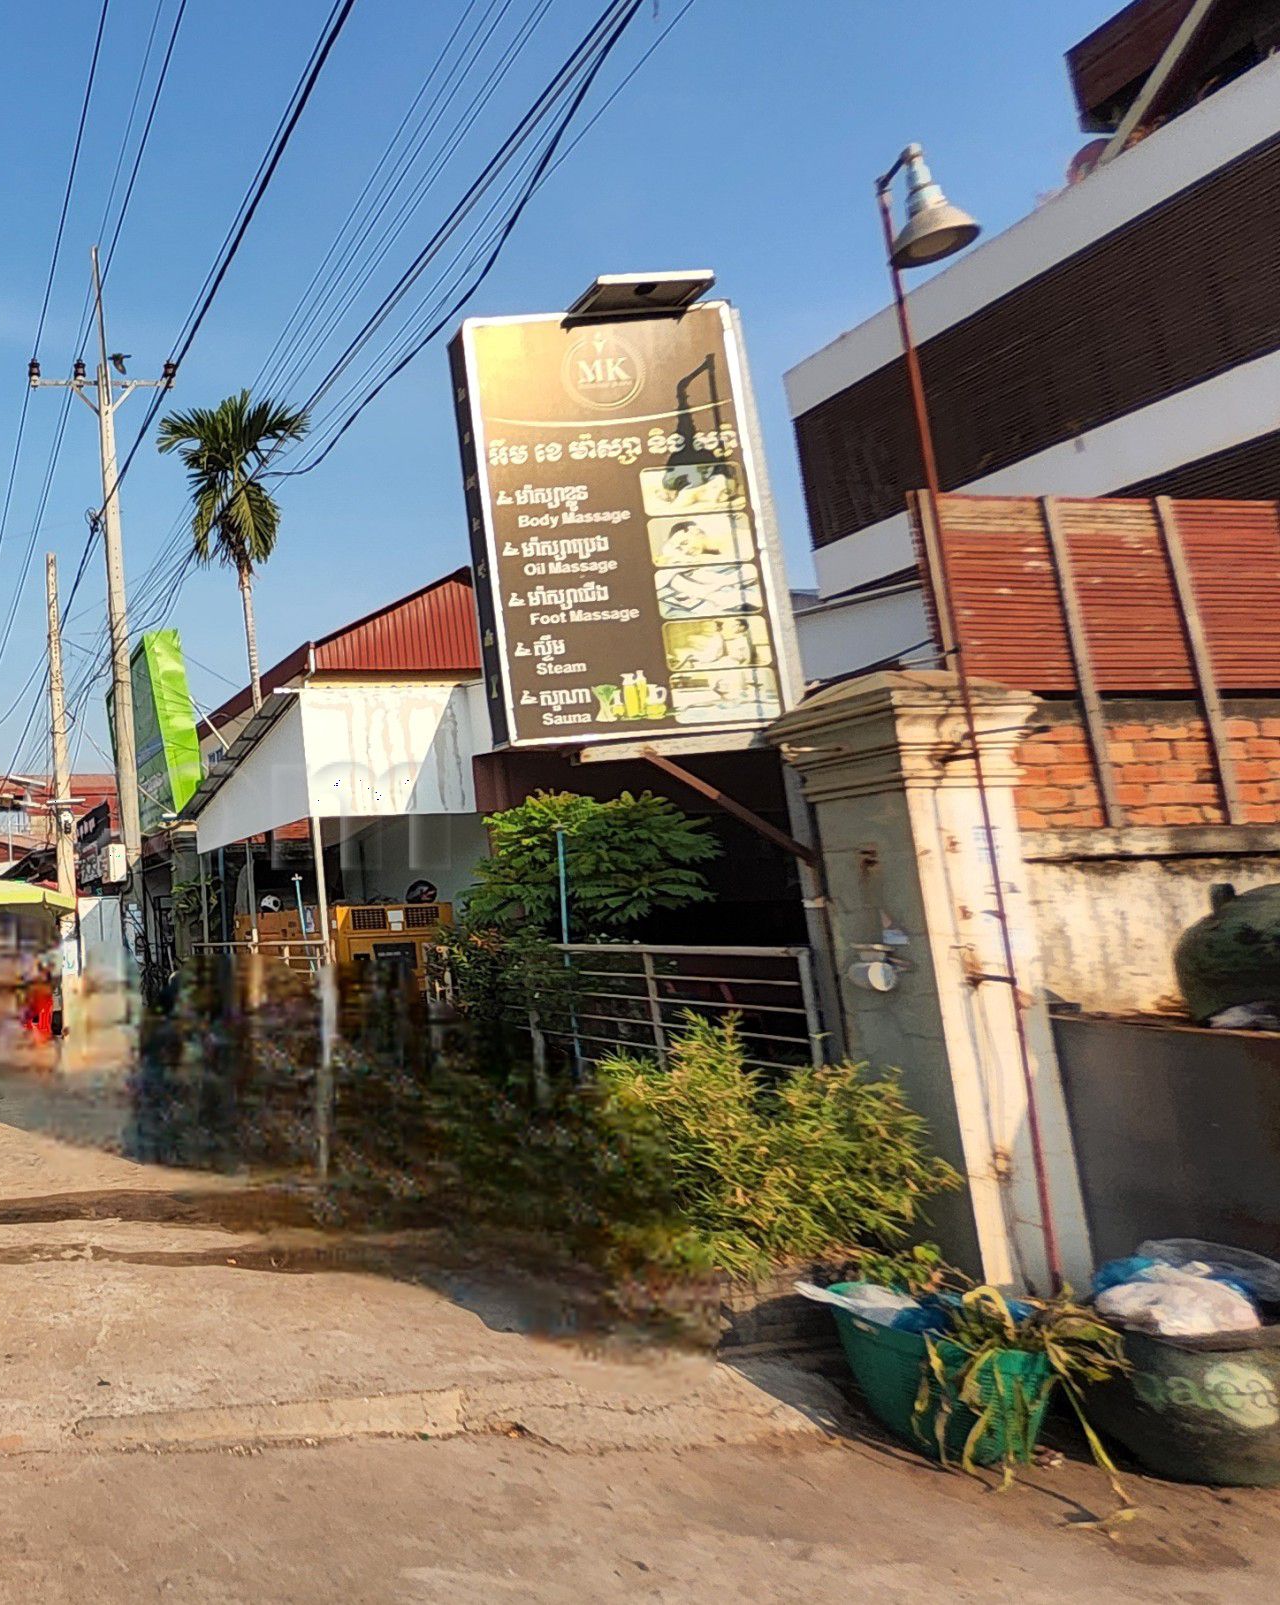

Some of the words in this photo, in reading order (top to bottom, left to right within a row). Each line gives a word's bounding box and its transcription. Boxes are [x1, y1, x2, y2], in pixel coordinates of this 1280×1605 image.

[577, 356, 632, 383] MK
[518, 513, 560, 529] Body
[561, 509, 632, 525] Massage
[523, 561, 547, 576] Oil
[548, 559, 618, 574] Massage
[529, 611, 568, 626] Foot
[569, 607, 640, 623] Massage
[535, 661, 587, 676] Steam
[542, 712, 592, 726] Sauna
